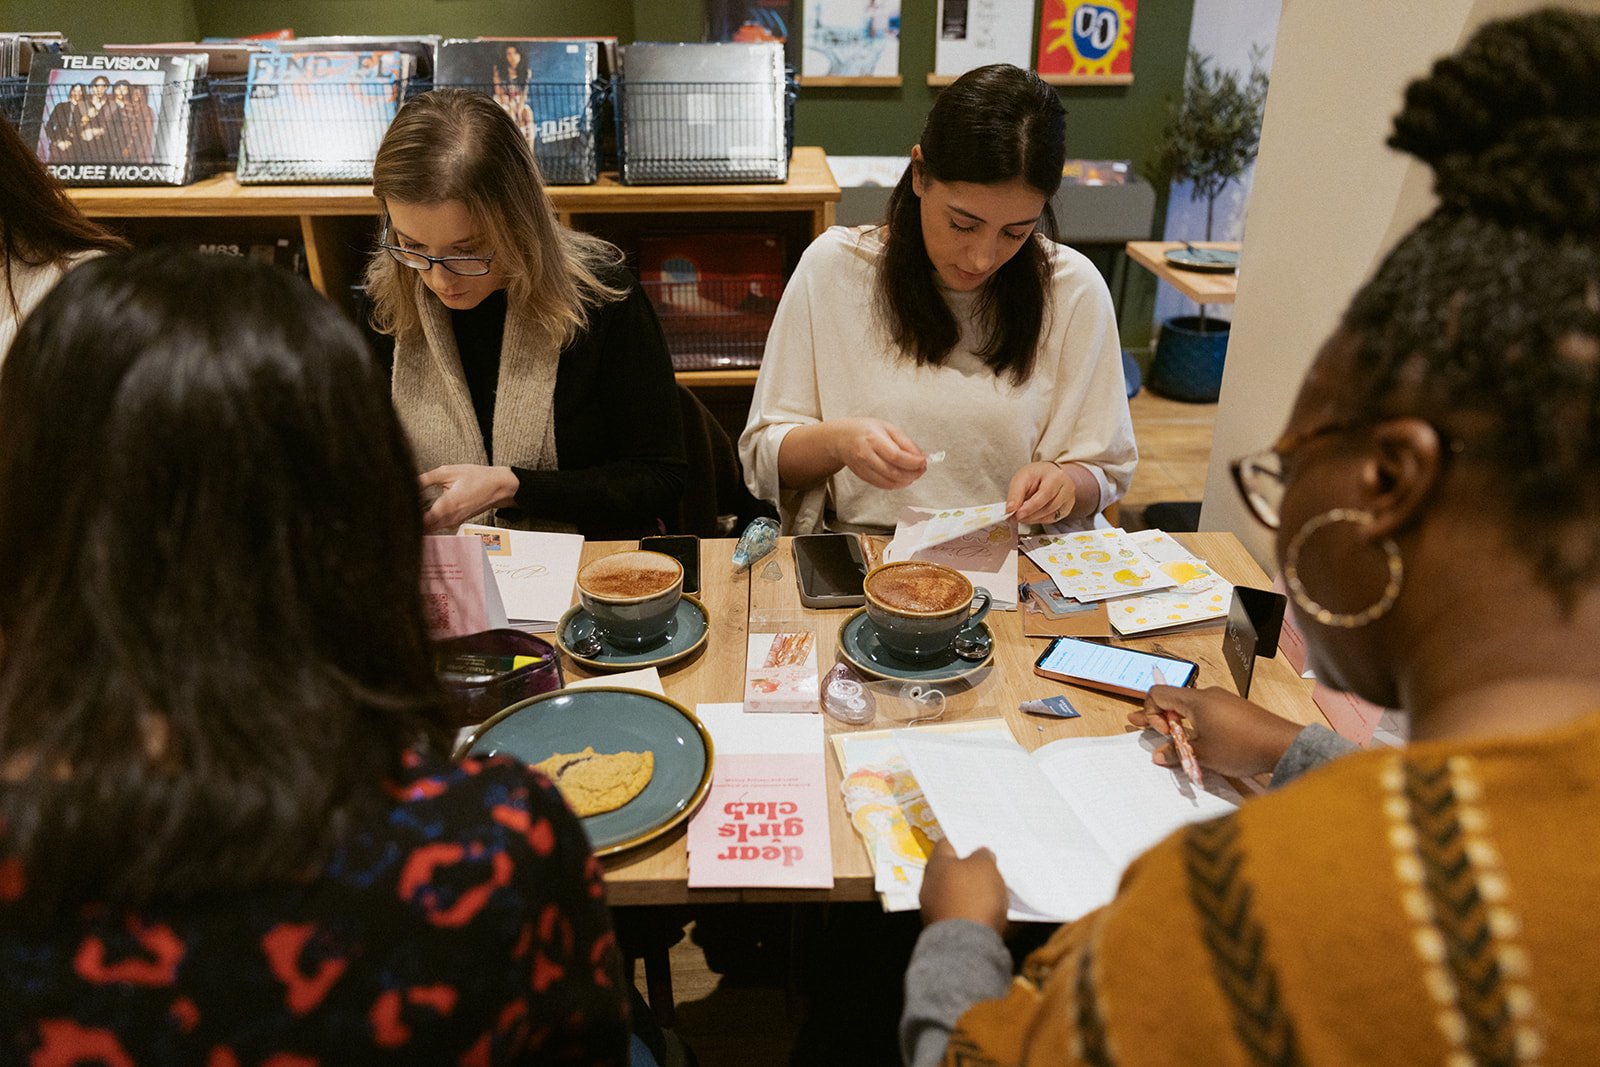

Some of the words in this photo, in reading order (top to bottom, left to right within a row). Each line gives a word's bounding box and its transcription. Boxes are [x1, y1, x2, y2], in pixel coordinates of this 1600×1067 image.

[61, 55, 160, 70] TELEVISION
[49, 164, 107, 180] RQUEE
[109, 165, 173, 180] MOON
[724, 801, 799, 820] club
[718, 817, 804, 843] girls
[717, 846, 804, 867] dear
